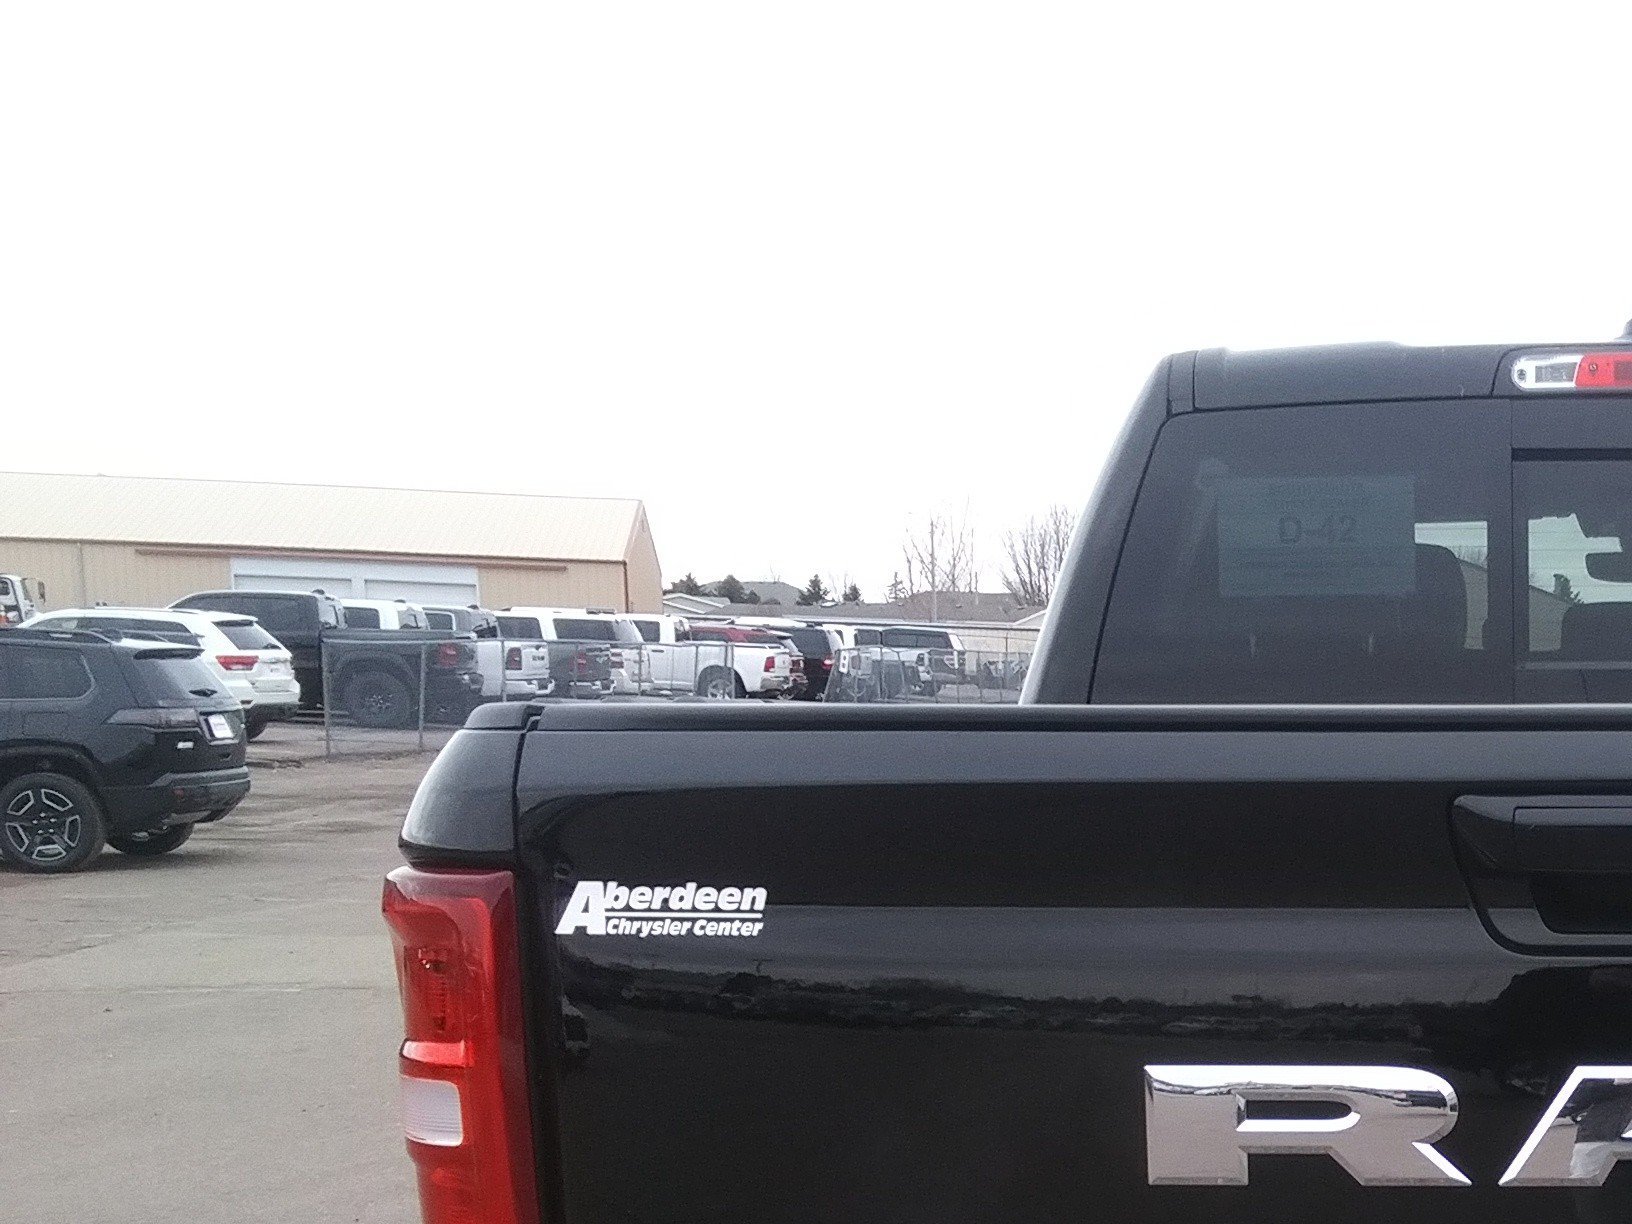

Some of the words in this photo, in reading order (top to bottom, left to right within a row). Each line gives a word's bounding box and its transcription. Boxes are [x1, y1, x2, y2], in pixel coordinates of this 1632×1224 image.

[1277, 514, 1358, 544] D-42
[554, 880, 768, 935] Aberdeen
[606, 918, 691, 938] Chrysler
[692, 918, 764, 937] Center
